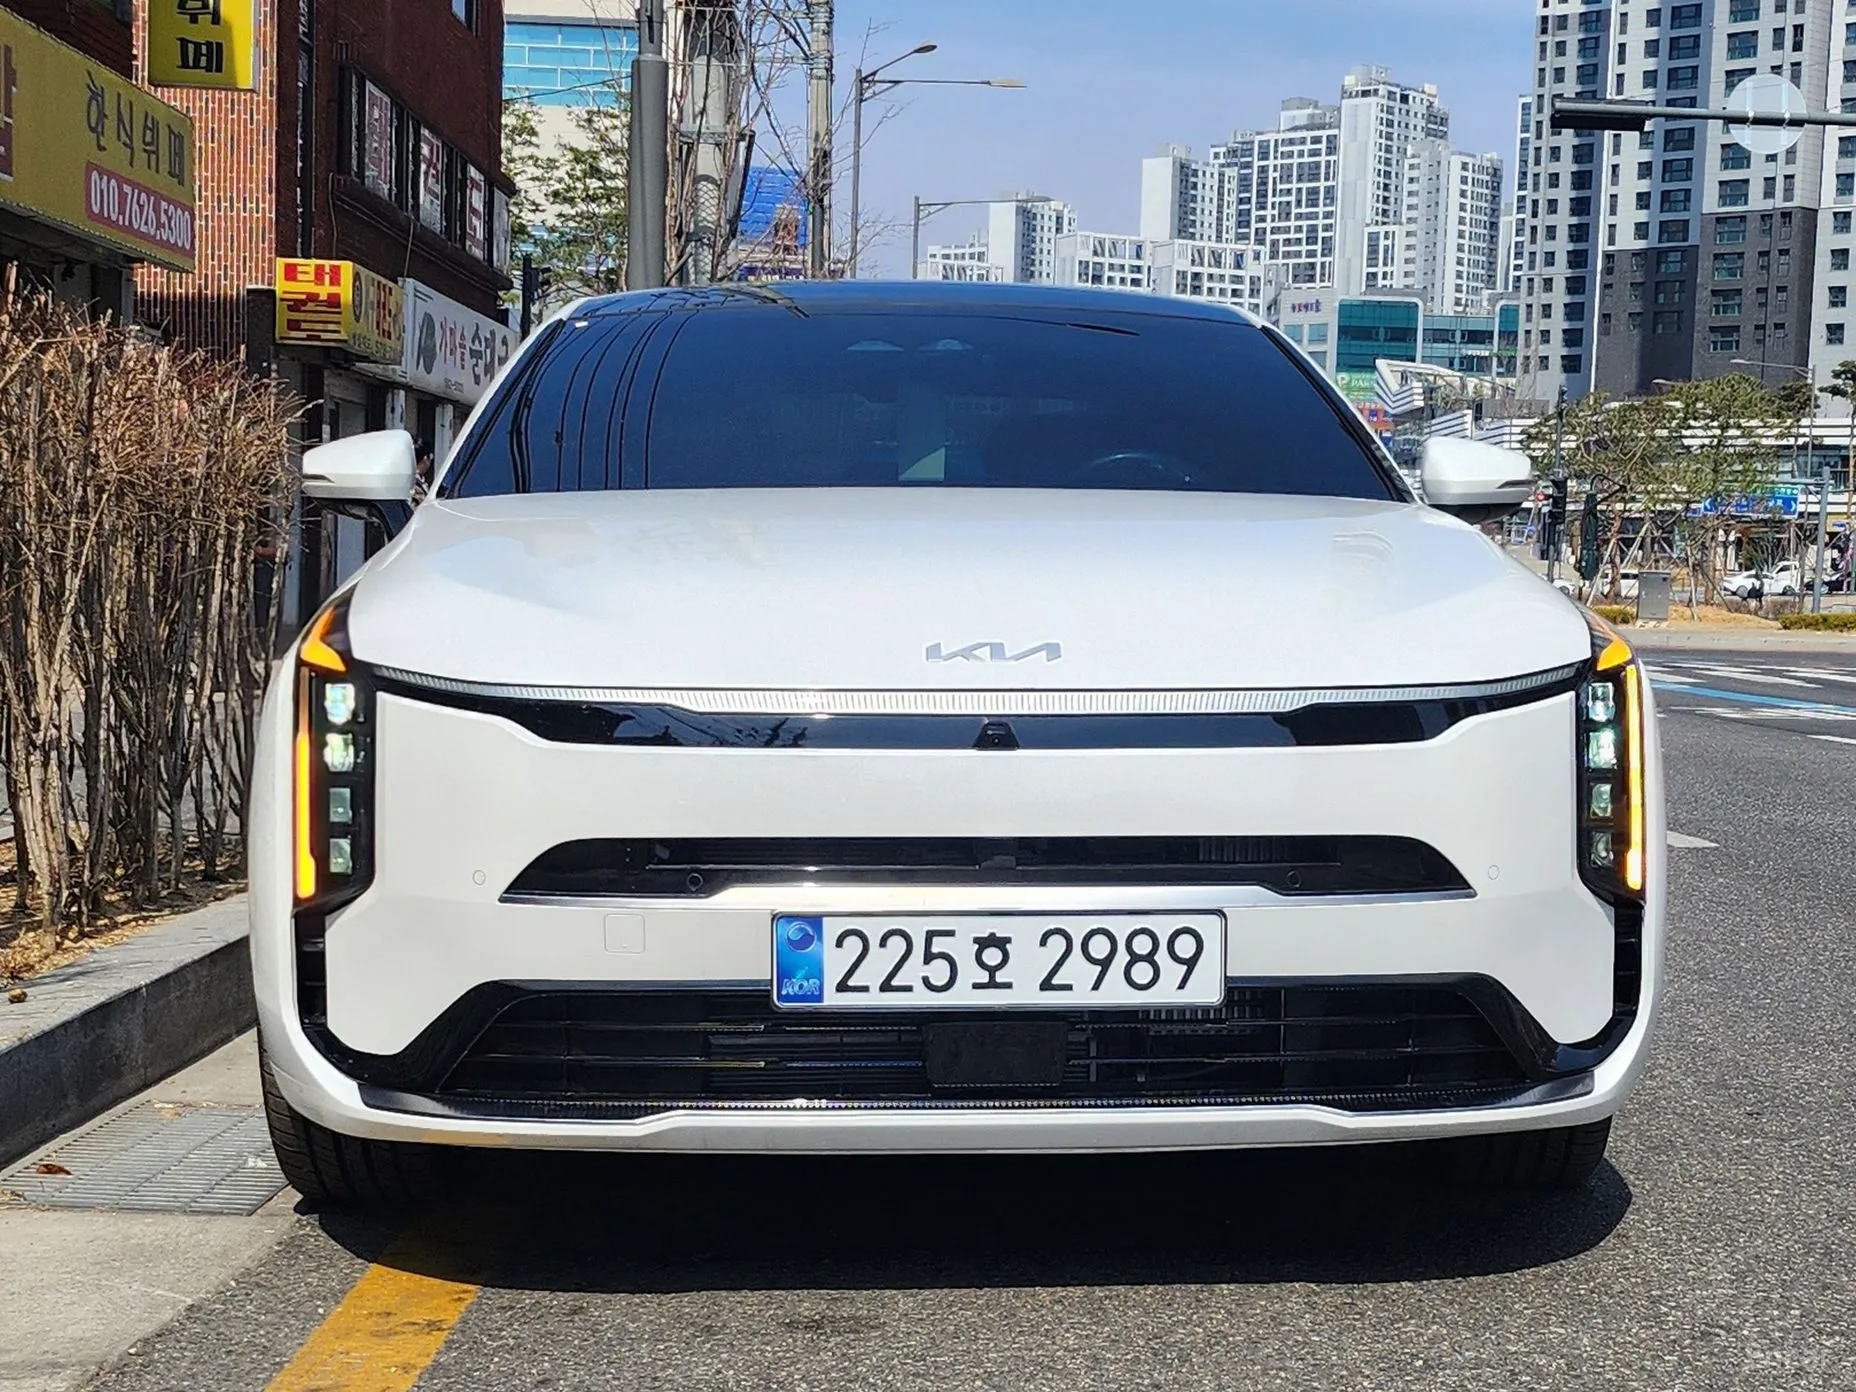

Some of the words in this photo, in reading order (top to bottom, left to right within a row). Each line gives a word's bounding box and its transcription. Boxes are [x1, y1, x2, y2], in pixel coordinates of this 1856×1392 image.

[85, 69, 185, 187] 한식뷔페
[781, 978, 821, 996] KOR
[834, 928, 1013, 993] 225호
[1038, 926, 1205, 992] 2989
